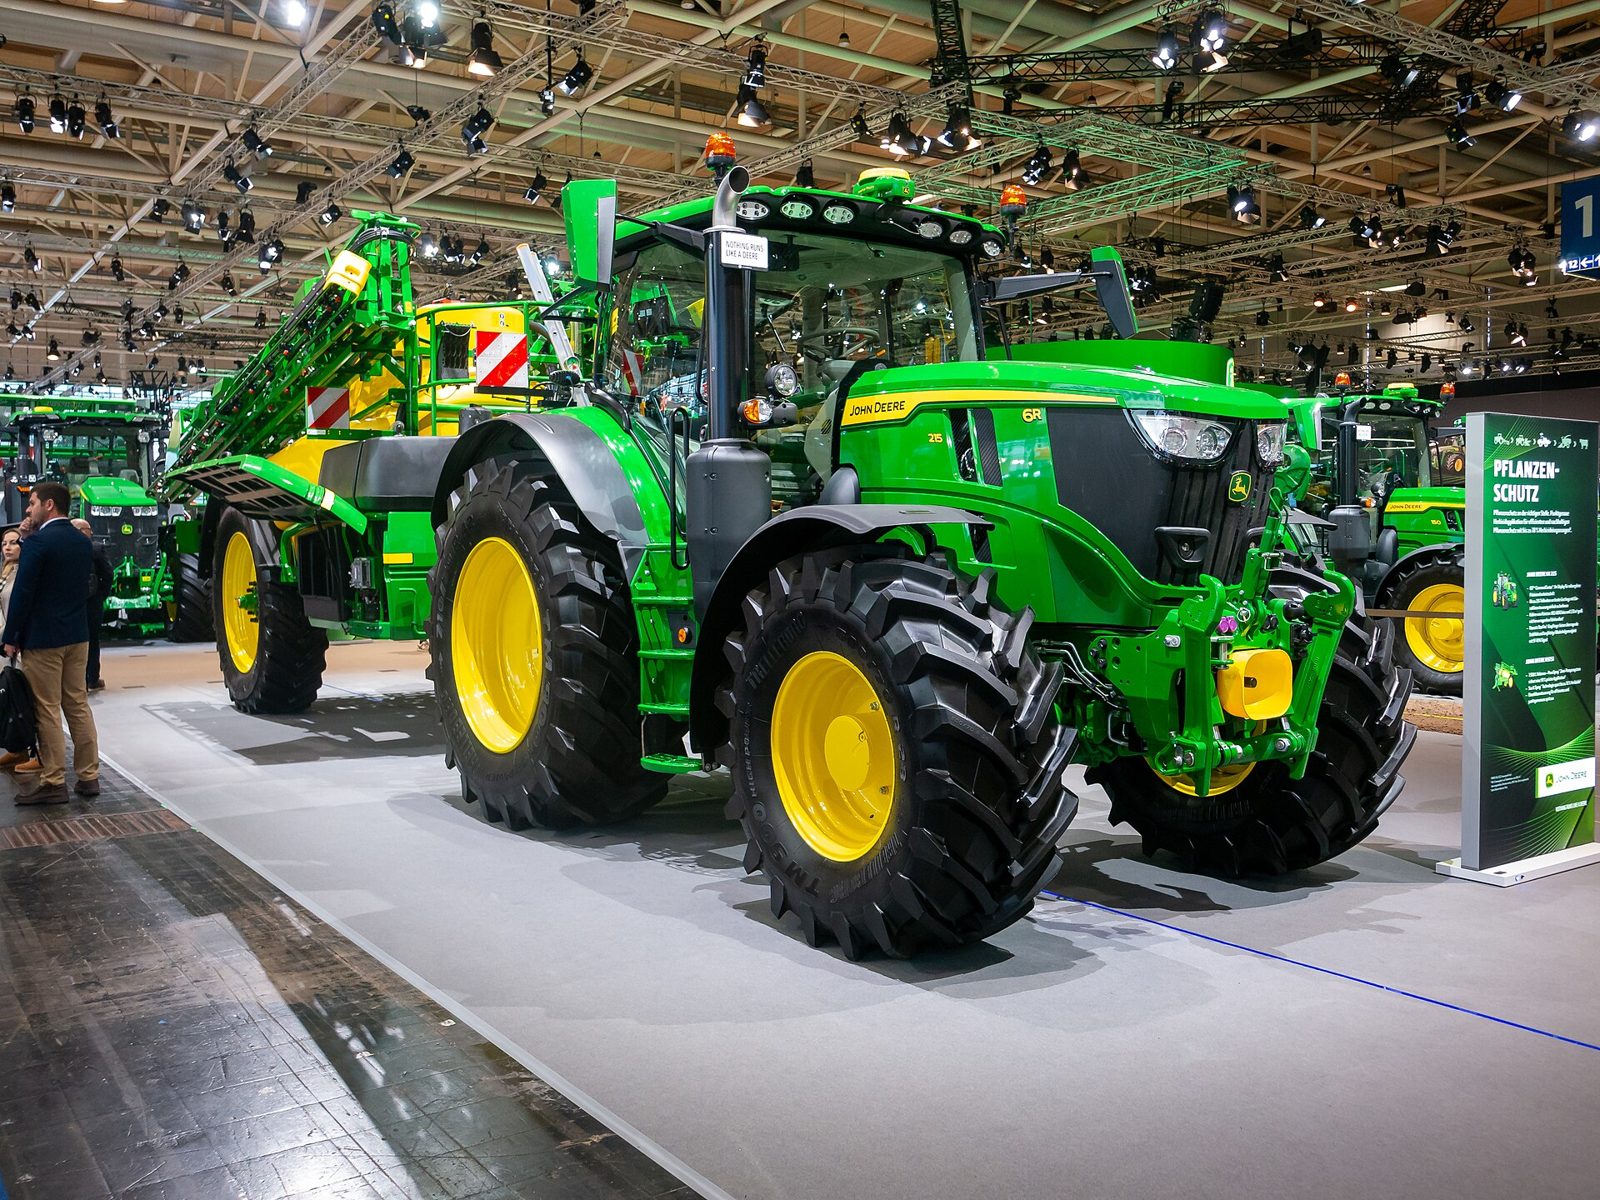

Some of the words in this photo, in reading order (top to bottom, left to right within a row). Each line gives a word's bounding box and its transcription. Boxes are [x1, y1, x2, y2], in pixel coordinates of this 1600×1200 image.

[726, 241, 749, 251] NOTHING
[751, 243, 763, 252] RUNS
[726, 249, 737, 257] LIKE
[743, 251, 758, 260] DEERE
[849, 403, 873, 417] JOHN
[874, 401, 906, 414] DEERE
[1022, 408, 1042, 423] 6R
[927, 433, 943, 443] 215
[1493, 459, 1560, 479] PFLANZEN-
[1493, 483, 1539, 502] SCHUTZ
